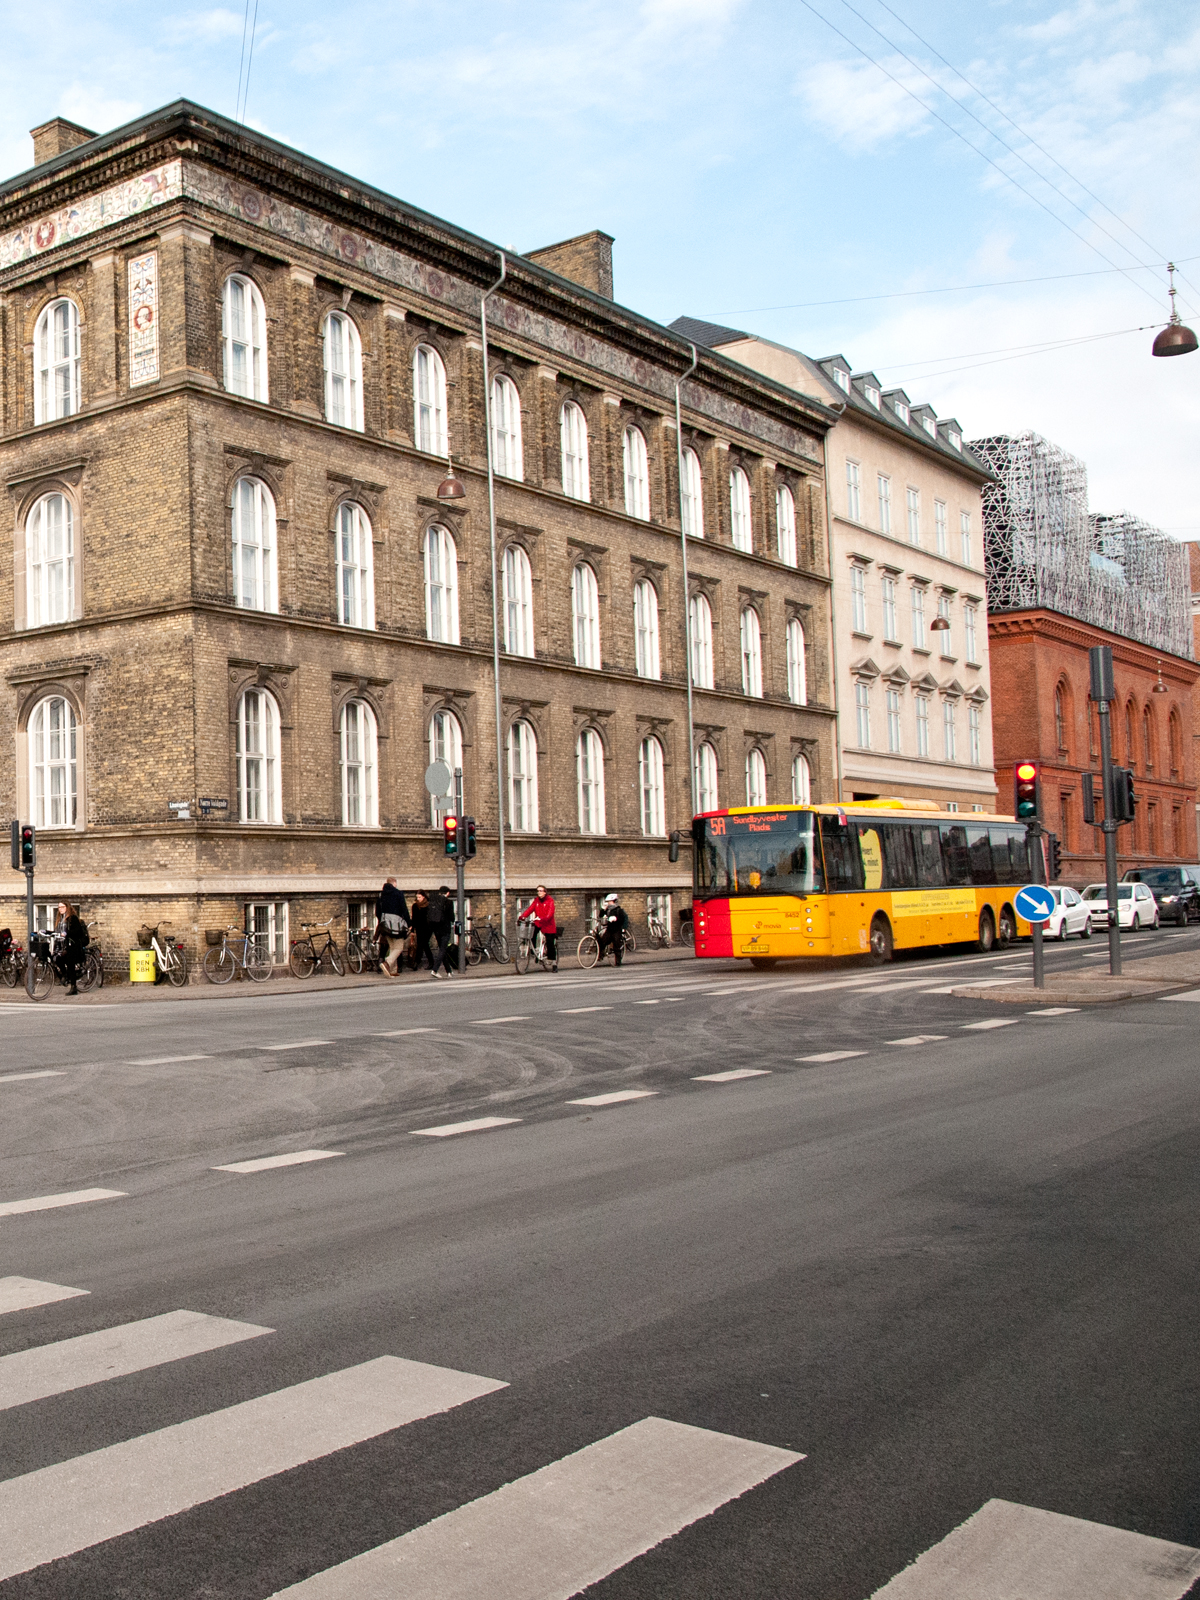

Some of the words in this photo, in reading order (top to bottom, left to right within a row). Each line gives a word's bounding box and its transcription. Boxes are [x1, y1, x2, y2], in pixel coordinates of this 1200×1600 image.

[732, 813, 788, 825] Sundbyvester
[710, 817, 726, 836] 5A
[748, 823, 771, 832] Plads
